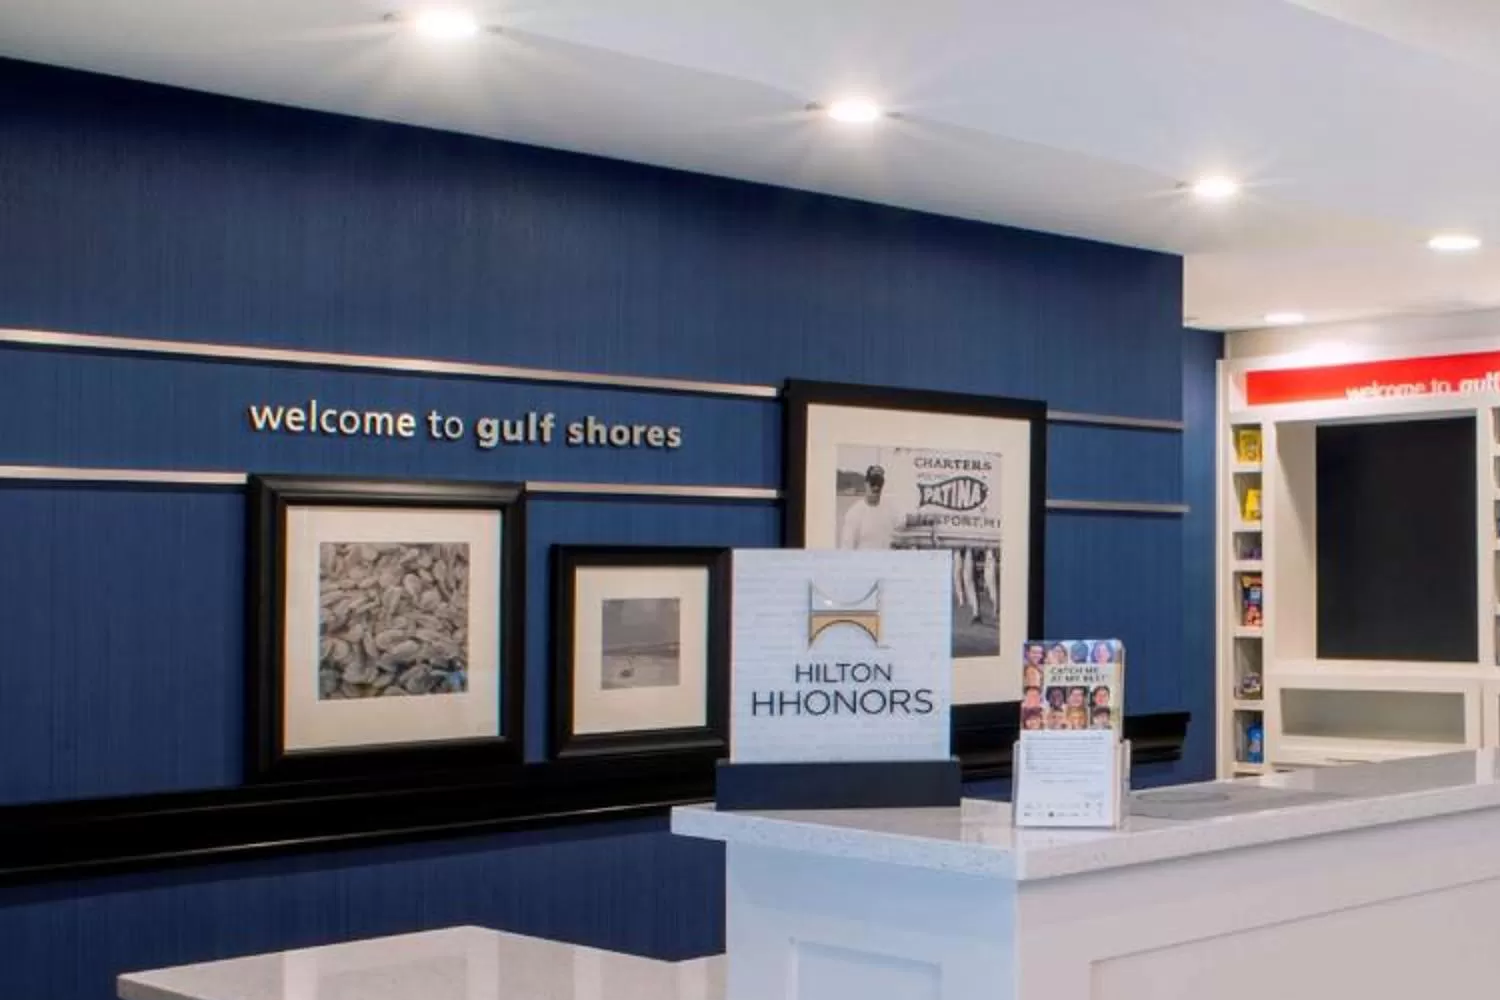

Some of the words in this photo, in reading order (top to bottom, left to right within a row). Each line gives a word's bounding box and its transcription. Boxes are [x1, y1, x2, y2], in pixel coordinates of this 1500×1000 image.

[1346, 380, 1427, 399] welcome
[1431, 378, 1449, 394] to
[250, 399, 416, 438] welcome
[428, 409, 464, 440] to
[476, 412, 556, 448] gulf
[567, 415, 682, 448] shores
[913, 457, 992, 470] CHARTERS
[795, 662, 893, 684] HILTON
[751, 688, 934, 717] HHONORS
